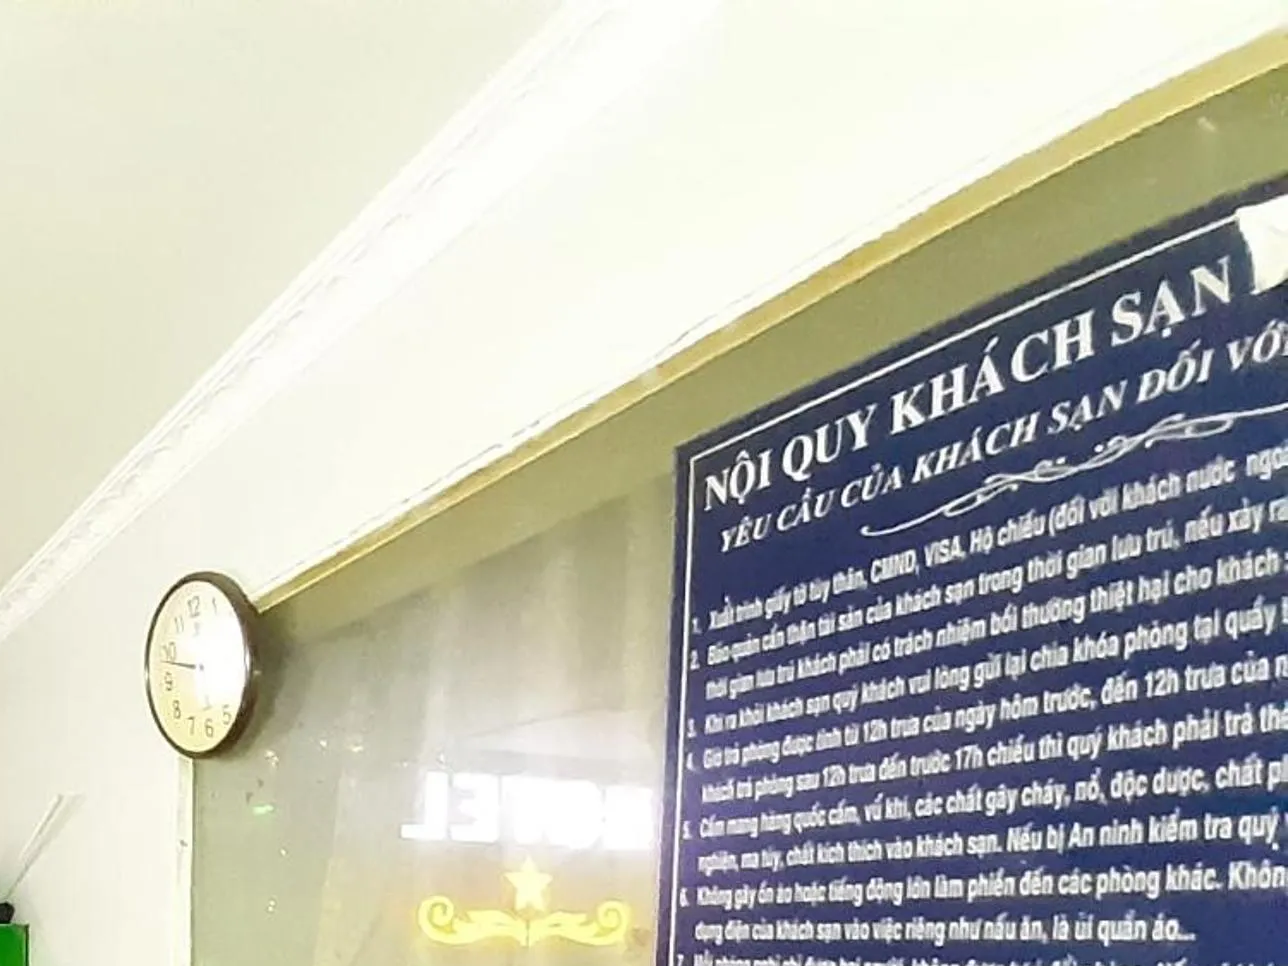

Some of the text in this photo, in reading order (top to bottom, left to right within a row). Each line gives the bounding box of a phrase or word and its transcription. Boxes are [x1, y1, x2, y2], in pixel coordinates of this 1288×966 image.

[703, 256, 1232, 511] NỘI QUY KHÁCH SẠN
[720, 514, 772, 552] YÊU
[777, 487, 834, 532] CẦU
[841, 464, 903, 508] CỦA
[912, 411, 1039, 483] KHÁCH
[1048, 379, 1130, 432] SẠN
[1136, 344, 1215, 403] ĐỐI
[1121, 473, 1180, 510] khách
[978, 566, 1022, 595] trong
[1066, 544, 1106, 579] gian
[1138, 570, 1169, 604] hại
[1174, 565, 1212, 594] cho
[1216, 548, 1280, 585] khách
[187, 595, 200, 618] 12
[1124, 620, 1187, 660] phòng
[1000, 693, 1038, 720] hôm
[1100, 672, 1138, 704] đến
[1144, 668, 1178, 697] 12h
[1185, 663, 1226, 691] trưa
[1231, 652, 1268, 685] của
[172, 700, 182, 720] 8
[205, 718, 215, 738] 6
[1066, 726, 1101, 761] quý
[1107, 718, 1167, 750] khách
[1173, 708, 1218, 749] phải
[1225, 703, 1252, 736] trả
[986, 784, 1018, 816] gây
[1215, 755, 1262, 788] chất
[1006, 823, 1042, 852] Nếu
[1068, 822, 1094, 848] An
[1099, 818, 1144, 846] ninh
[1148, 811, 1197, 843] kiểm
[1204, 814, 1232, 840] tra
[1058, 868, 1092, 895] các
[1096, 866, 1160, 900] phòng
[1166, 862, 1222, 891] khác.
